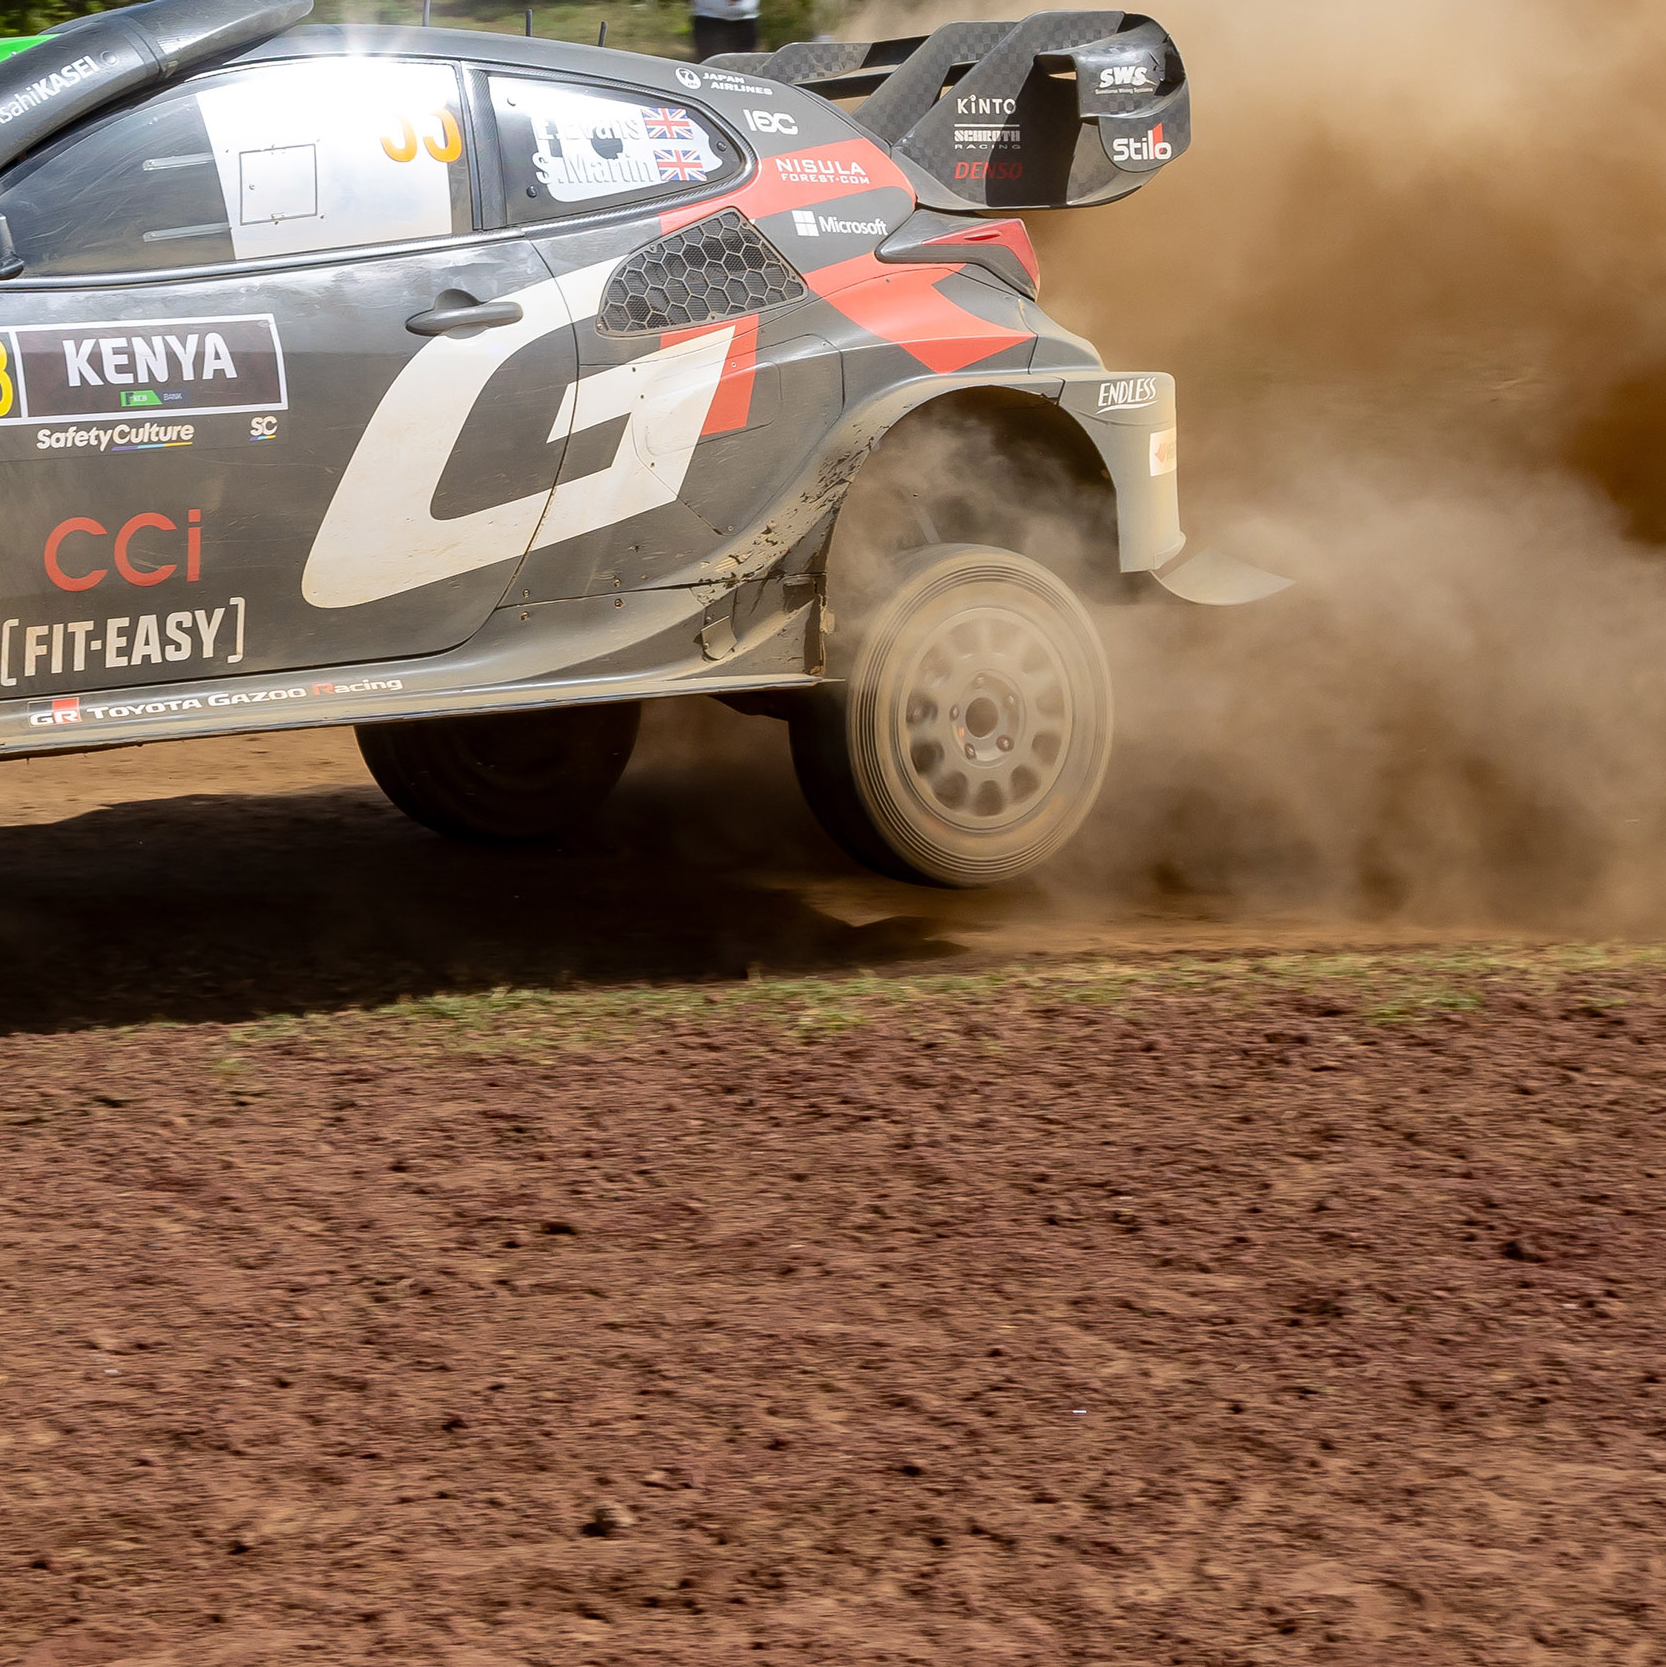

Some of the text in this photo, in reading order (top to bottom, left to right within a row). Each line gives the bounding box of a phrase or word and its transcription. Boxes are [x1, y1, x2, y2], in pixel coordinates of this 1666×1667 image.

[702, 72, 745, 84] JAPAN
[1099, 65, 1149, 88] SWS
[710, 82, 774, 96] AIRLINES
[954, 130, 1021, 142] SCHROTH
[1112, 122, 1173, 162] Stilo
[775, 157, 867, 176] NISULA
[954, 161, 1023, 180] DENSO
[818, 215, 888, 236] Microsoft
[62, 332, 238, 387] KENYA
[1098, 377, 1157, 407] ENDLESS
[36, 422, 195, 452] SafetyCulture
[250, 416, 279, 438] SC
[30, 678, 404, 727] GR TOYOTA GAZOO Racing
